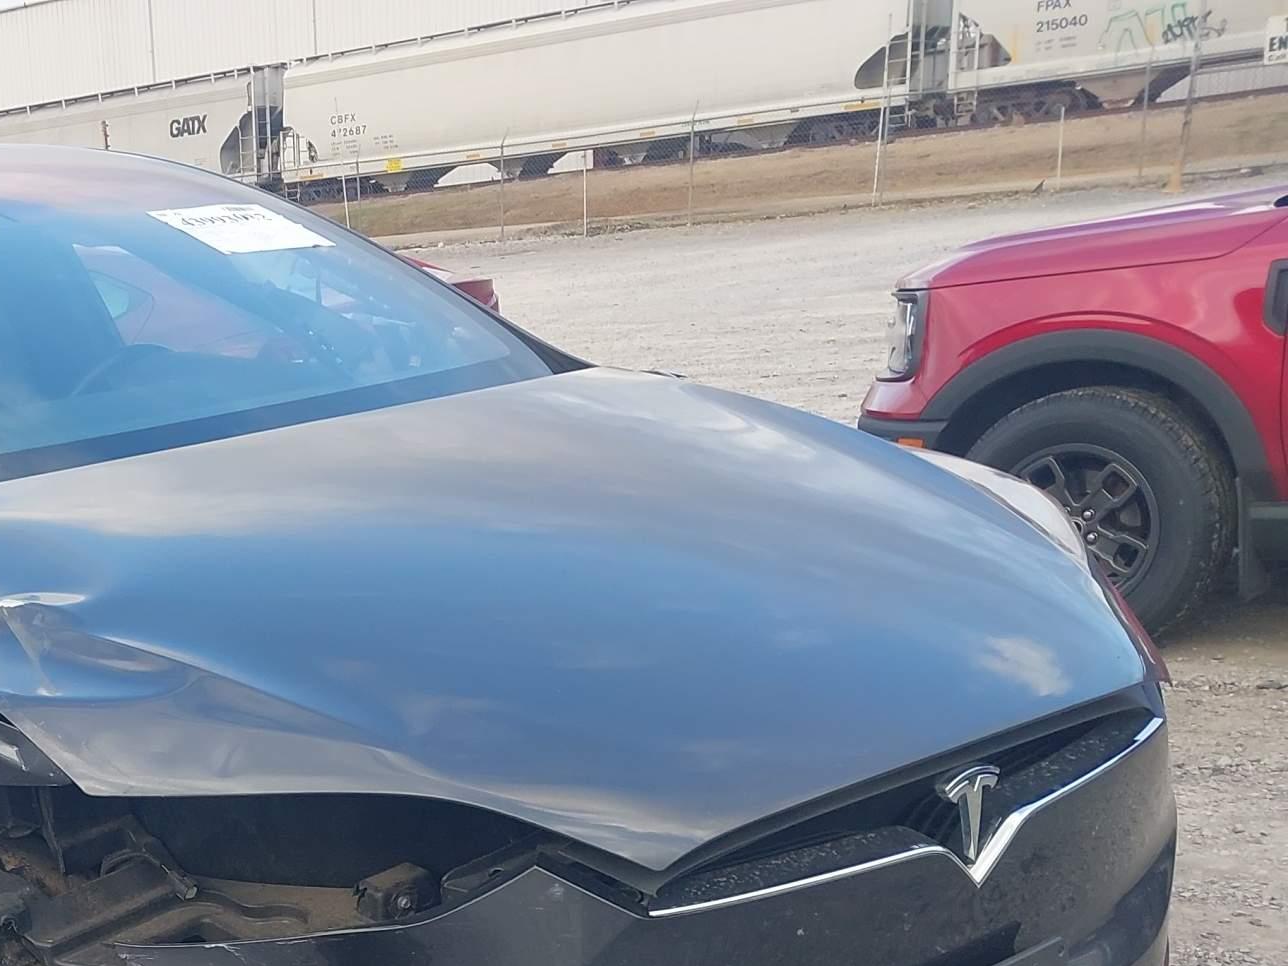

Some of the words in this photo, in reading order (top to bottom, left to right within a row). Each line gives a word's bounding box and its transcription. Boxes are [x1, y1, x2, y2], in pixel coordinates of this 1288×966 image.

[1036, 0, 1072, 12] FPAX
[1036, 14, 1088, 32] 215040
[170, 114, 207, 138] GATX
[330, 113, 356, 125] CBFX
